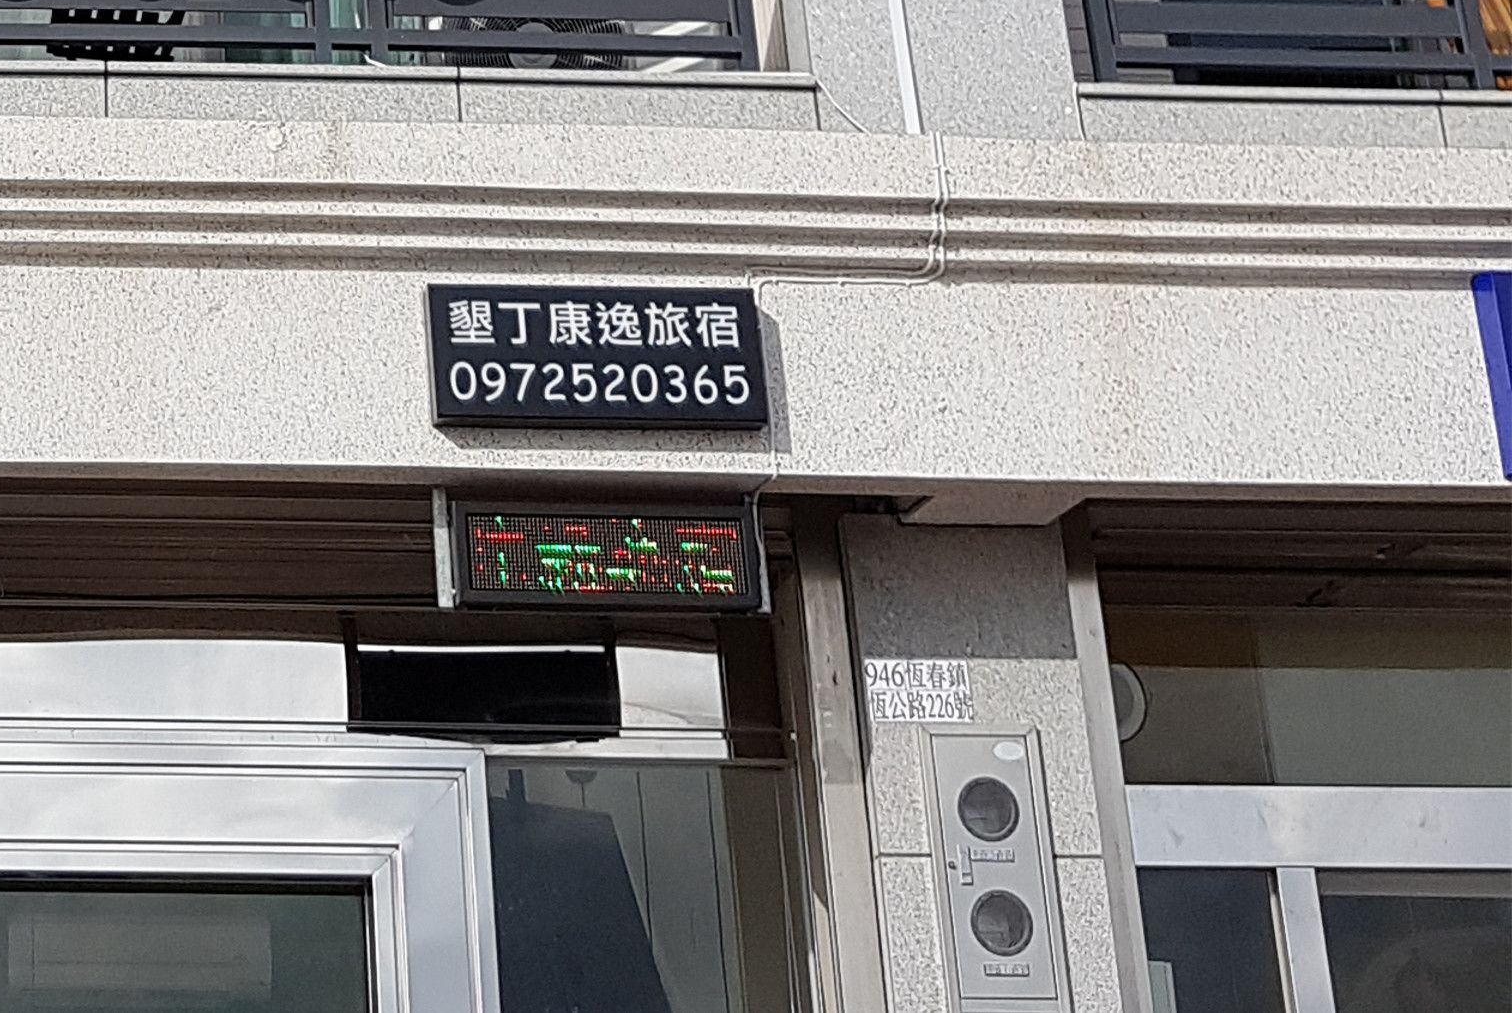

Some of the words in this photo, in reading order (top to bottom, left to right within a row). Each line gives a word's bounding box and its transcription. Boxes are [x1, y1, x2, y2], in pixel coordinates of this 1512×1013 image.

[449, 299, 741, 348] 墾丁康逸旅宿
[449, 361, 750, 405] 0972520365
